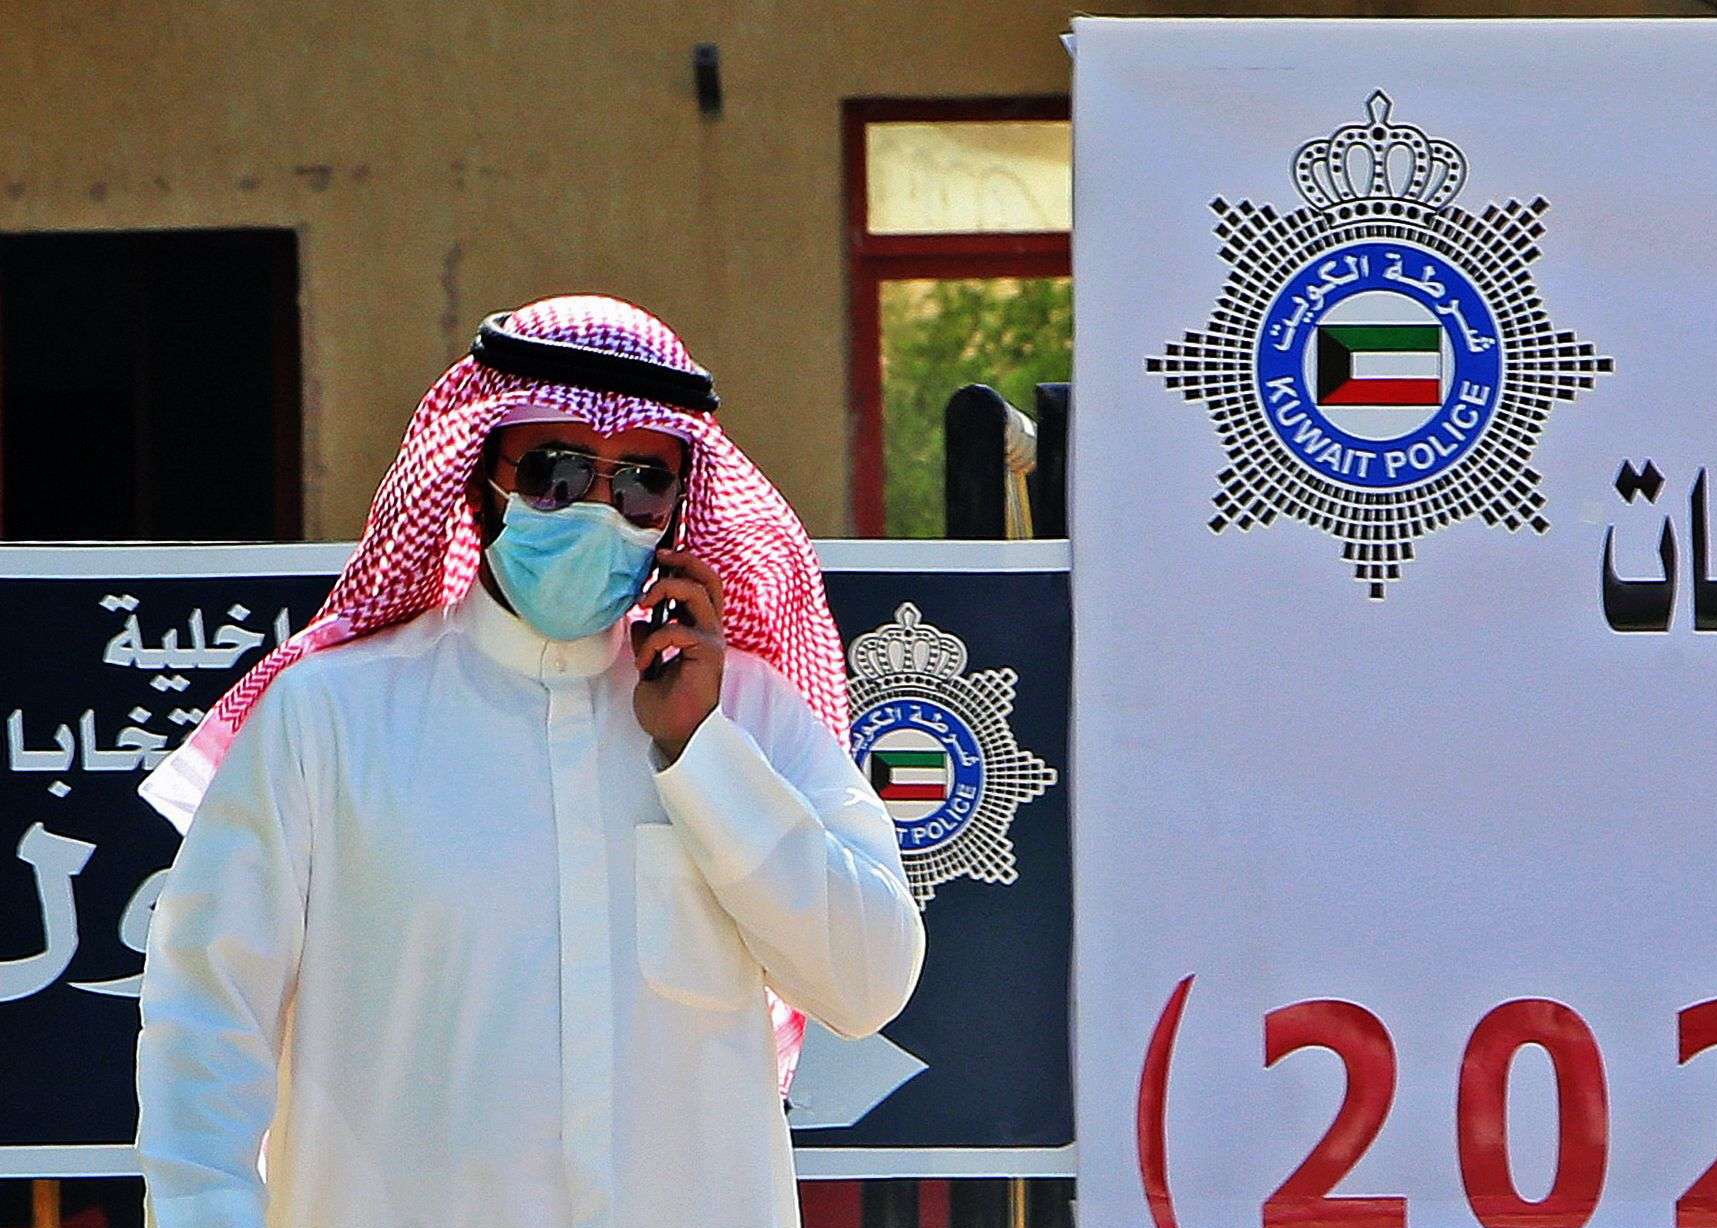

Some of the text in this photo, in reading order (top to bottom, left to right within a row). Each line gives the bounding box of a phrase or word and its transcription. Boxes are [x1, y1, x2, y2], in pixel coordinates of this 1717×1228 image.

[1269, 252, 1496, 353] شرطة الكويت
[1265, 376, 1491, 479] KUWAIT POLICE
[99, 594, 291, 692] اخلية
[908, 705, 980, 767] شرطة
[912, 784, 978, 845] POLICE
